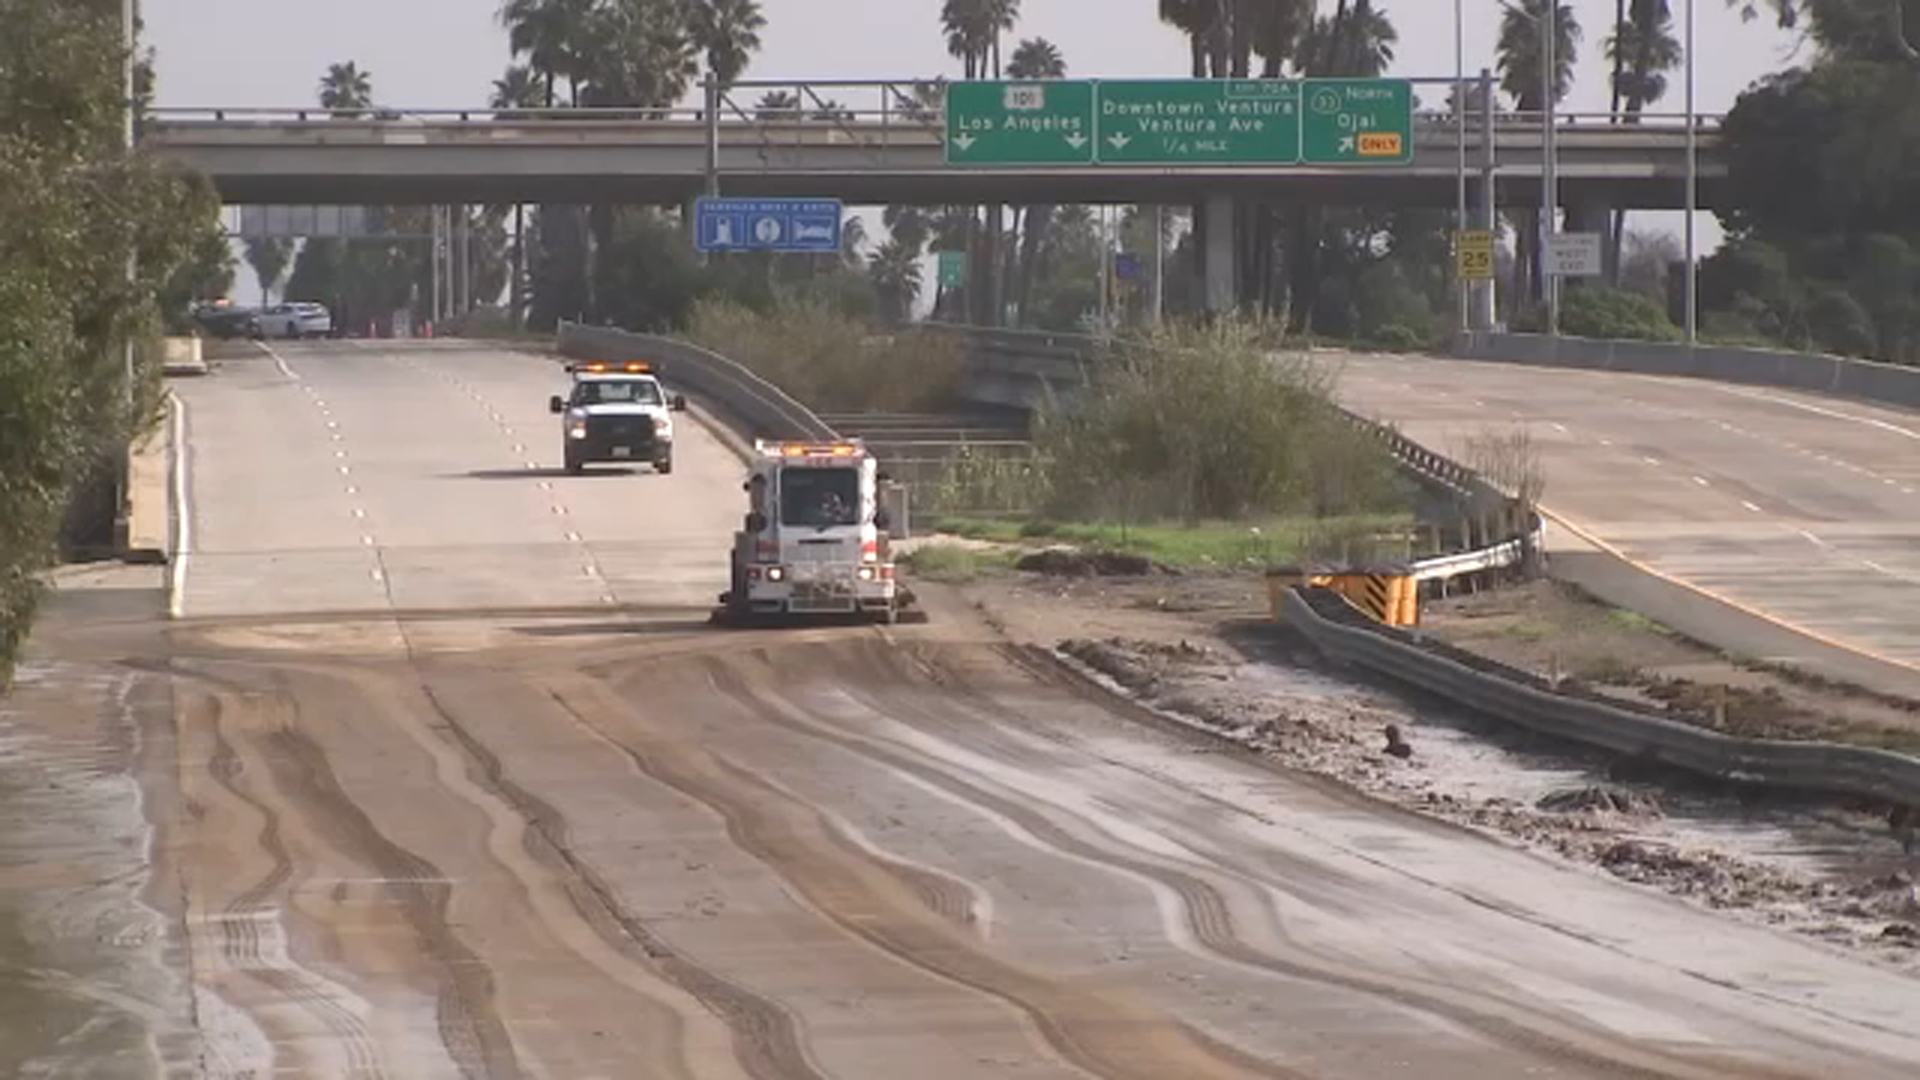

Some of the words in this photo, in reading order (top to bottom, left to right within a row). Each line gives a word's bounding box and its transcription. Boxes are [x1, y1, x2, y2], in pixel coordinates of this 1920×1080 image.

[1103, 99, 1204, 115] Downtown
[1217, 100, 1293, 115] Ventura
[959, 115, 993, 130] Los
[1004, 115, 1081, 132] Angeles
[1138, 117, 1217, 132] Ventura
[1229, 117, 1264, 132] Ave
[1337, 112, 1377, 132] Ojai
[1361, 137, 1399, 151] ONLY
[1462, 251, 1489, 268] 25
